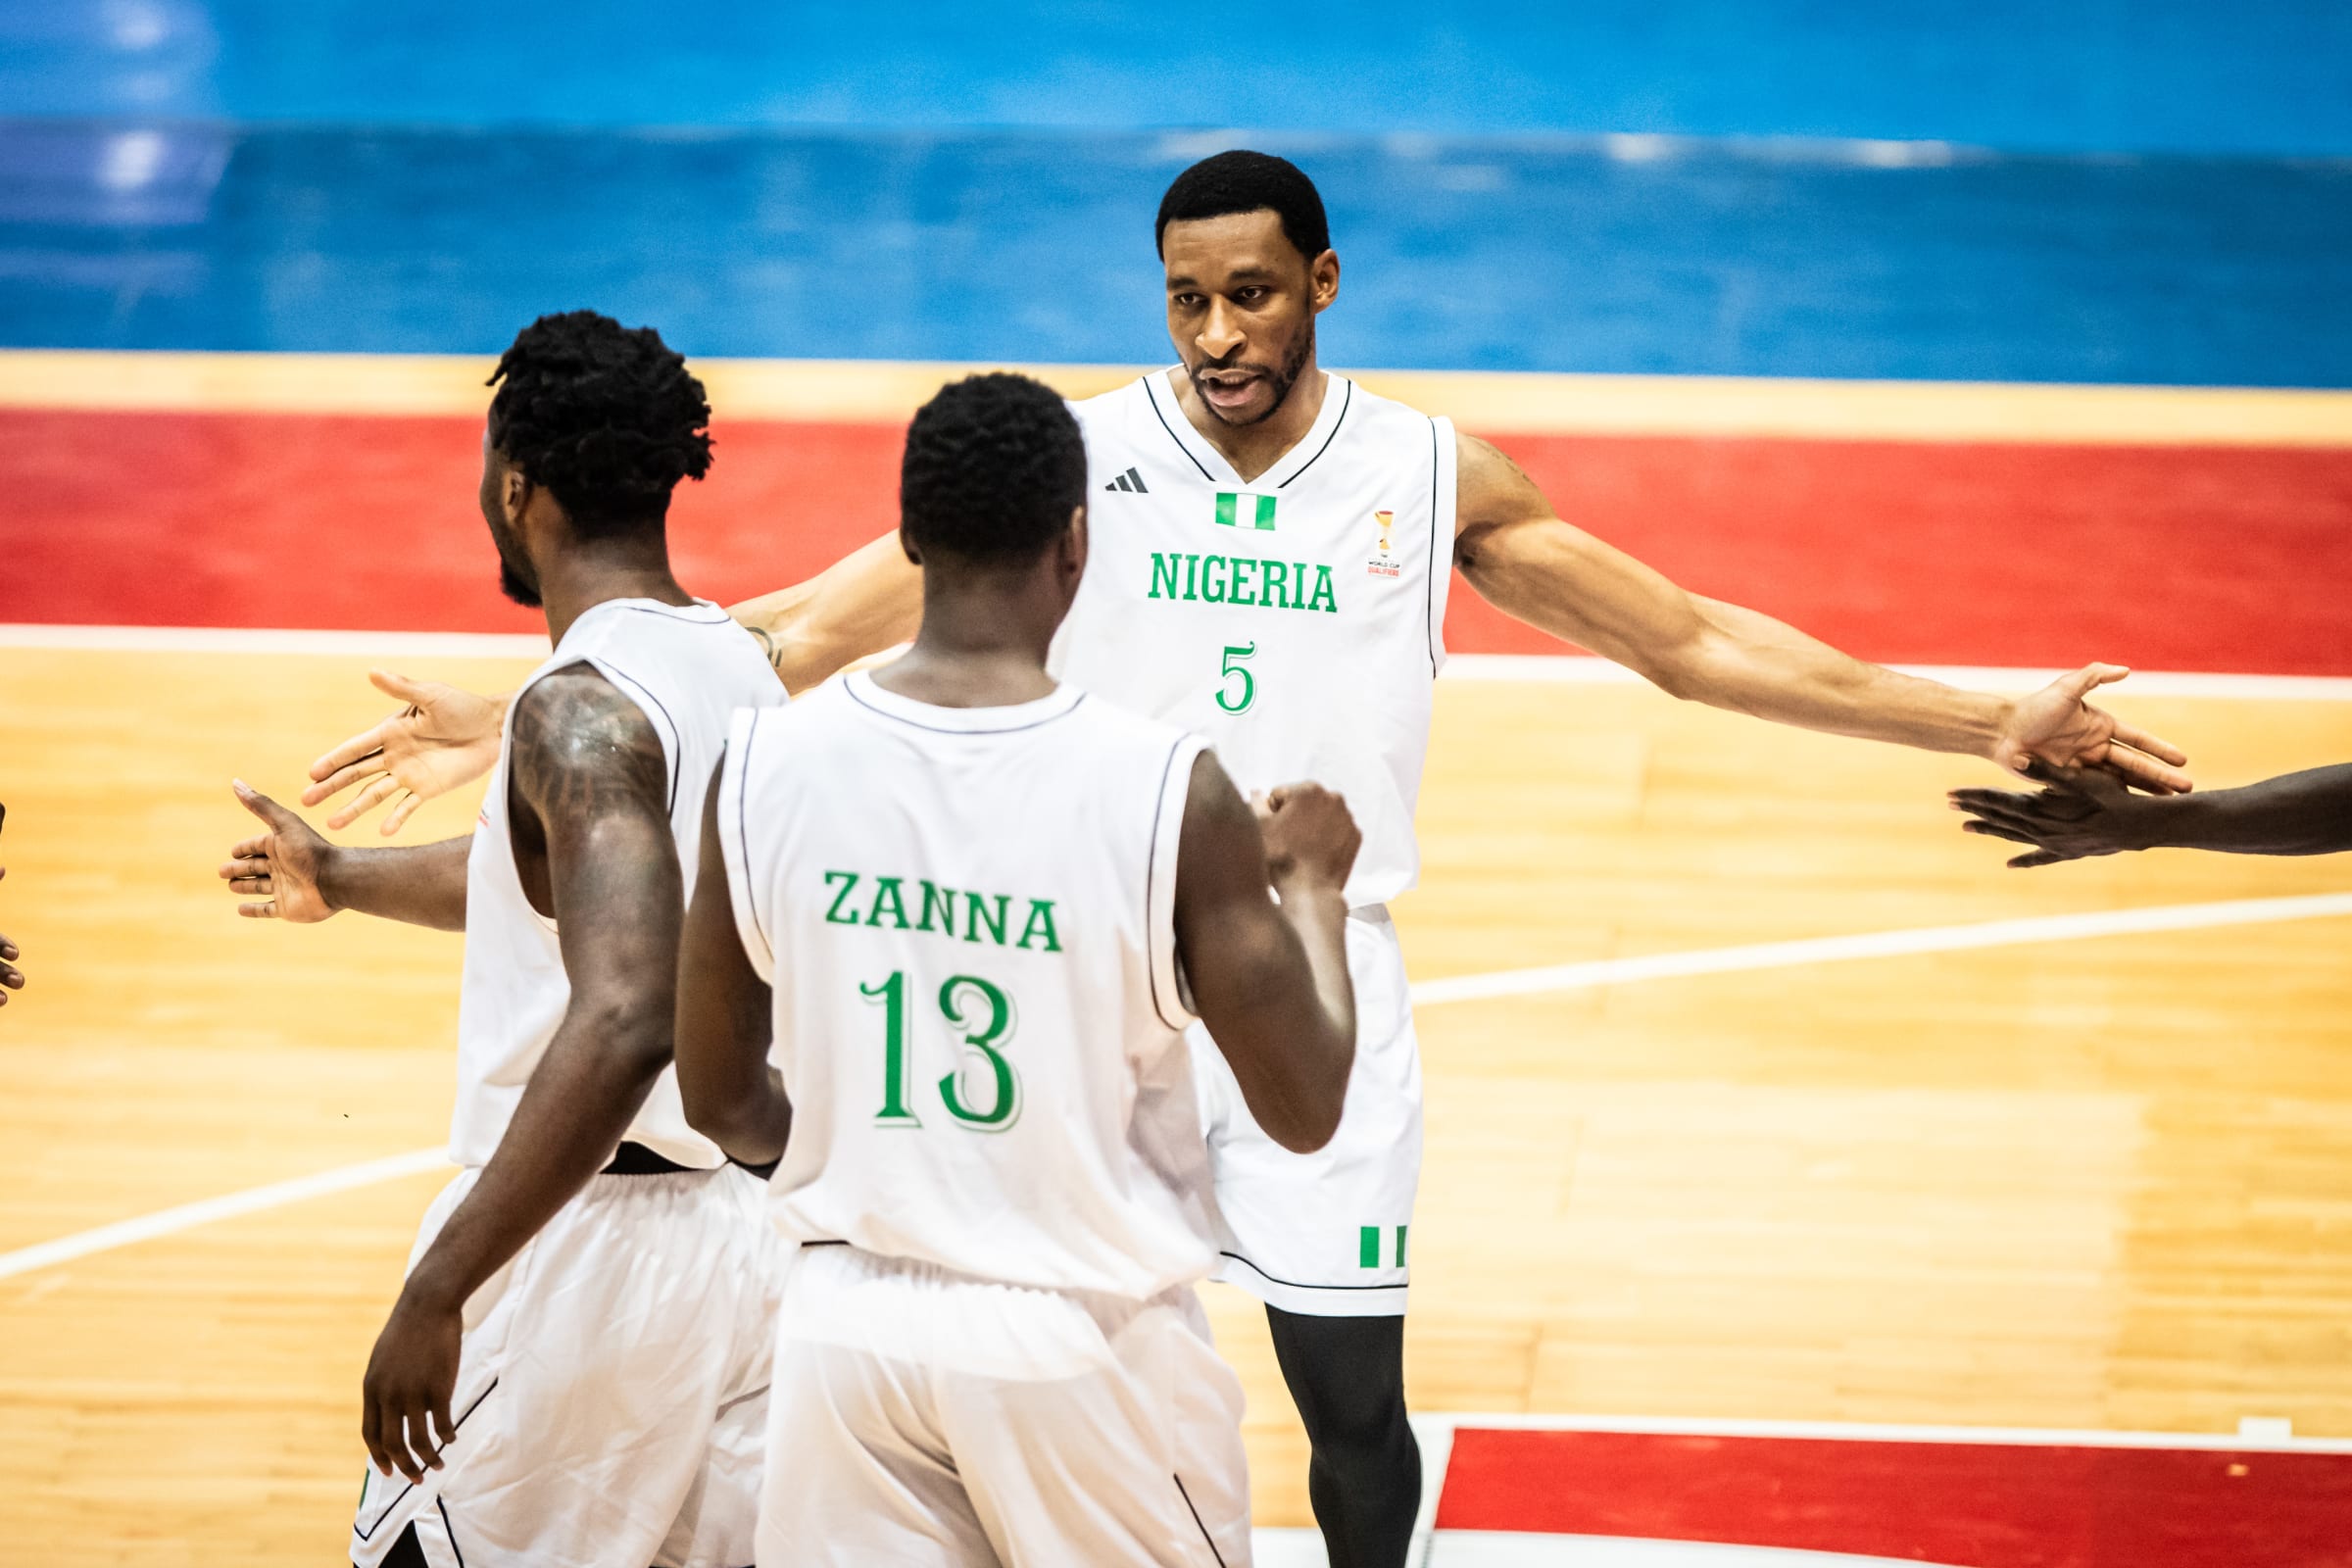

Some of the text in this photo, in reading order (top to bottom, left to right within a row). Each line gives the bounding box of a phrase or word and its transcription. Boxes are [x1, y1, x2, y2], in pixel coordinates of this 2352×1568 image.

[1147, 552, 1339, 613] NIGERIA
[1214, 640, 1257, 715] 5
[823, 870, 1062, 953] ZANNA
[858, 969, 1020, 1131] 13
